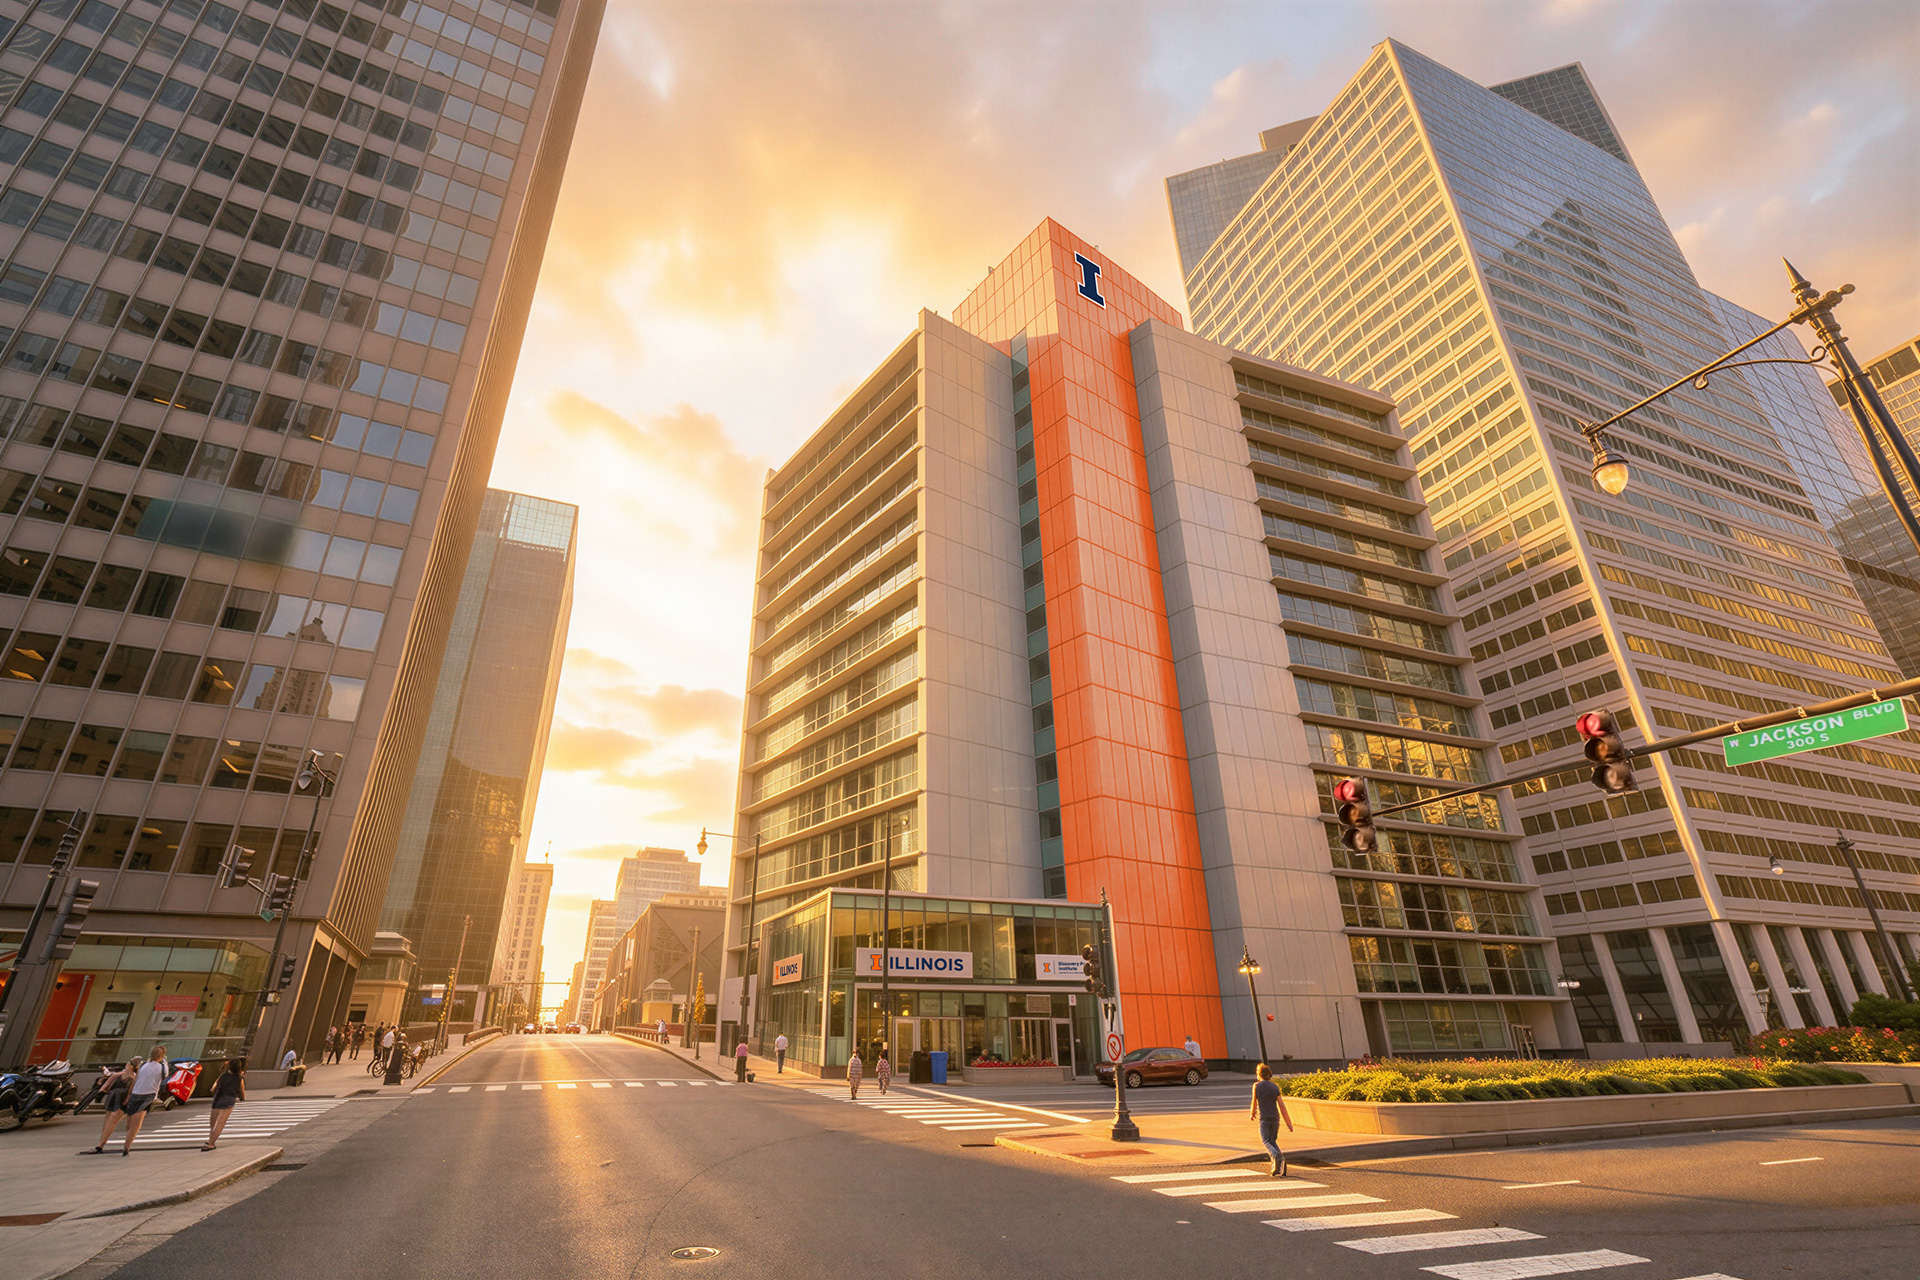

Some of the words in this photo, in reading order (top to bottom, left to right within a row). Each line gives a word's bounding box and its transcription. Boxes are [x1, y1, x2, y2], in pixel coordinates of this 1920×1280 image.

[1074, 250, 1106, 309] I
[1729, 739, 1739, 748] W
[1749, 715, 1844, 747] JACKSON
[1853, 703, 1896, 720] BLVD
[1787, 736, 1815, 749] 300
[1820, 733, 1830, 742] S
[870, 954, 882, 971] I
[890, 957, 964, 971] ILLINOIS
[1043, 963, 1051, 972] I
